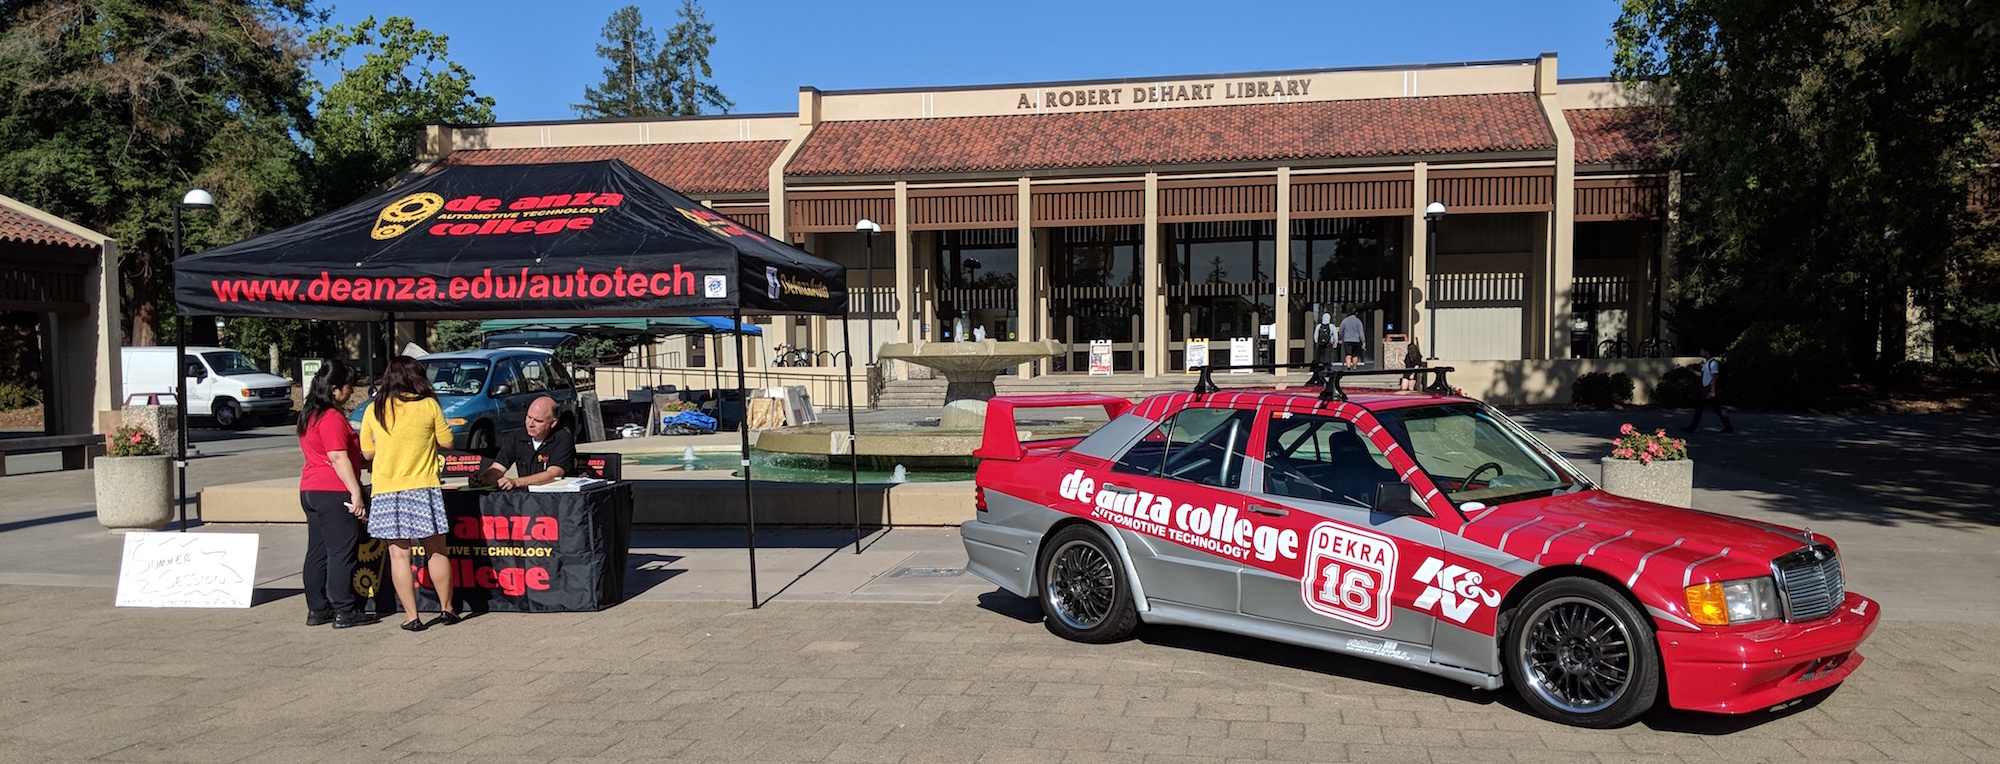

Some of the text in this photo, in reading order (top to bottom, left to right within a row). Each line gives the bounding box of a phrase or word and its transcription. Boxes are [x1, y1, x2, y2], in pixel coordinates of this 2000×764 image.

[1017, 78, 1312, 109] A. ROBERT DEHART LIBRARY
[437, 207, 608, 221] AUTOMOTIVE TECHNOLOGY
[444, 191, 624, 212] de anza
[428, 216, 595, 237] college
[211, 264, 696, 303] www.deanza.edu/autotech
[446, 464, 481, 472] college
[458, 454, 482, 462] anza
[454, 515, 559, 541] anza
[1059, 469, 1299, 562] de anza college
[1091, 507, 1250, 561] AUTOMOTIVE TECHNOLOGY
[411, 545, 553, 557] TOTIVE TECHNOLOGY
[1318, 532, 1386, 567] DEKRA
[1318, 562, 1375, 613] 16
